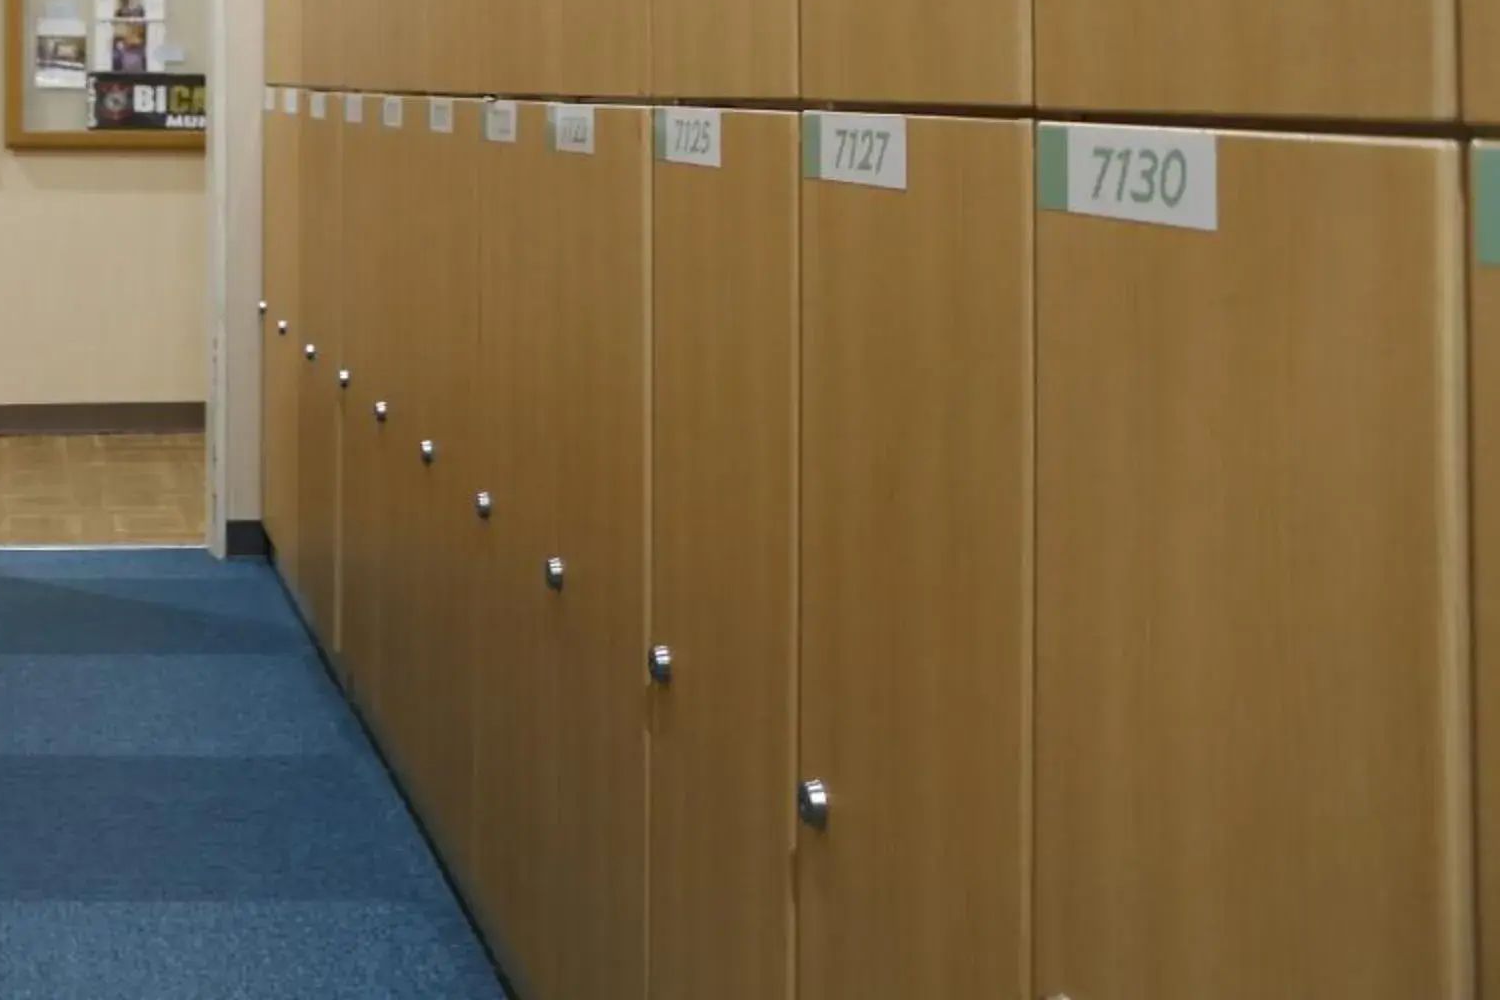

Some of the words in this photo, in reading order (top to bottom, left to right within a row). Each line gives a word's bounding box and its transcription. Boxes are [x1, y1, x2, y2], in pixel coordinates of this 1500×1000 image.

[674, 119, 711, 154] 7125
[834, 129, 890, 176] 7127
[1090, 146, 1188, 209] 7130
